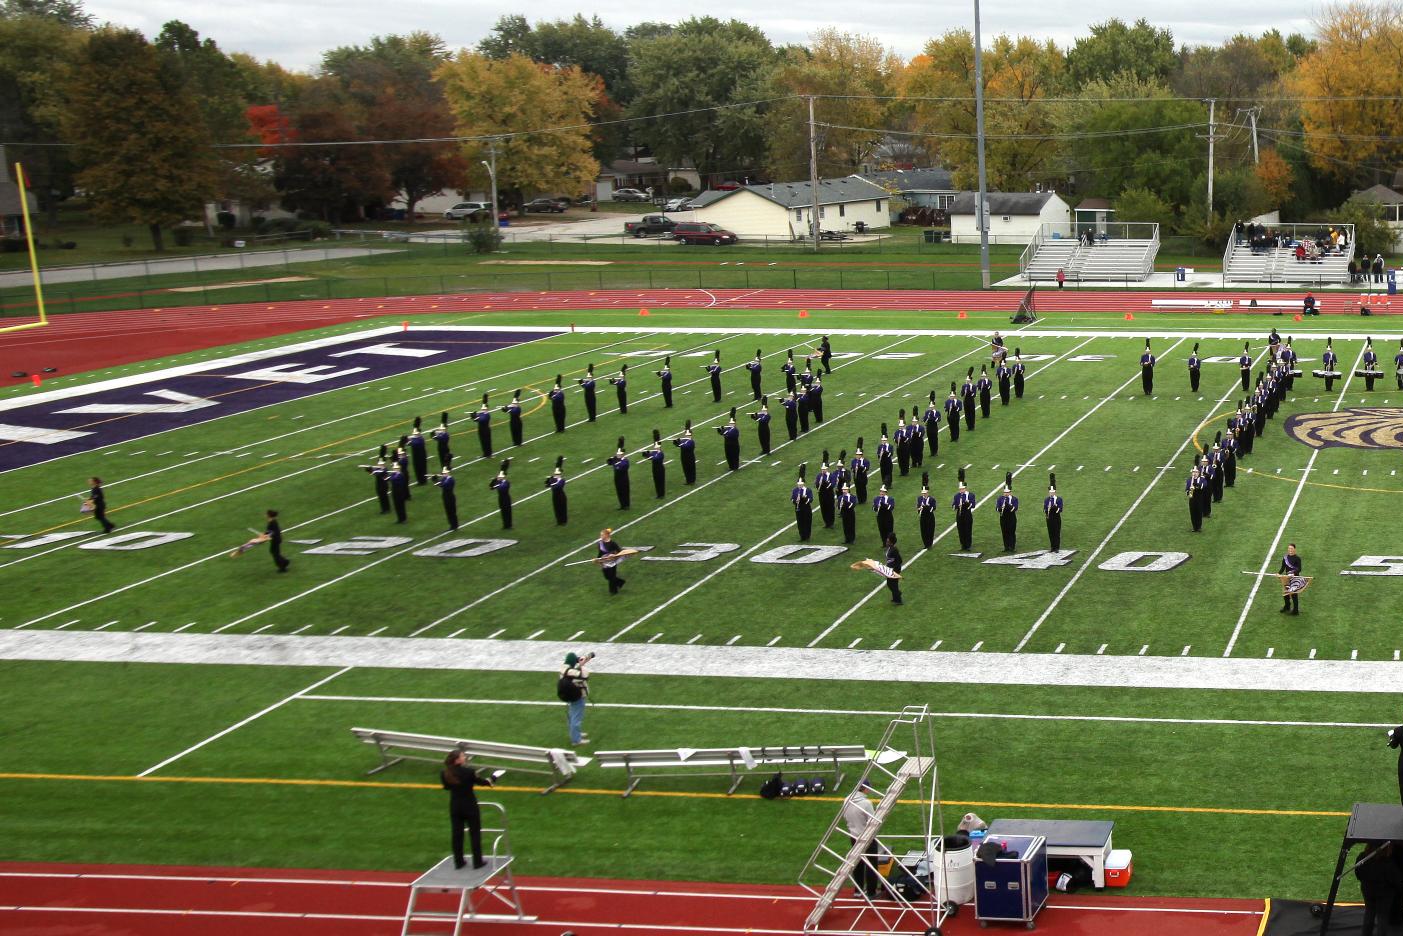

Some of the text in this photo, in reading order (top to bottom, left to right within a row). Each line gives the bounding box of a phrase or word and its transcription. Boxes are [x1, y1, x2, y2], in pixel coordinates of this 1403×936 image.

[302, 536, 518, 557] 20
[641, 542, 848, 564] 30
[981, 548, 1193, 572] 40
